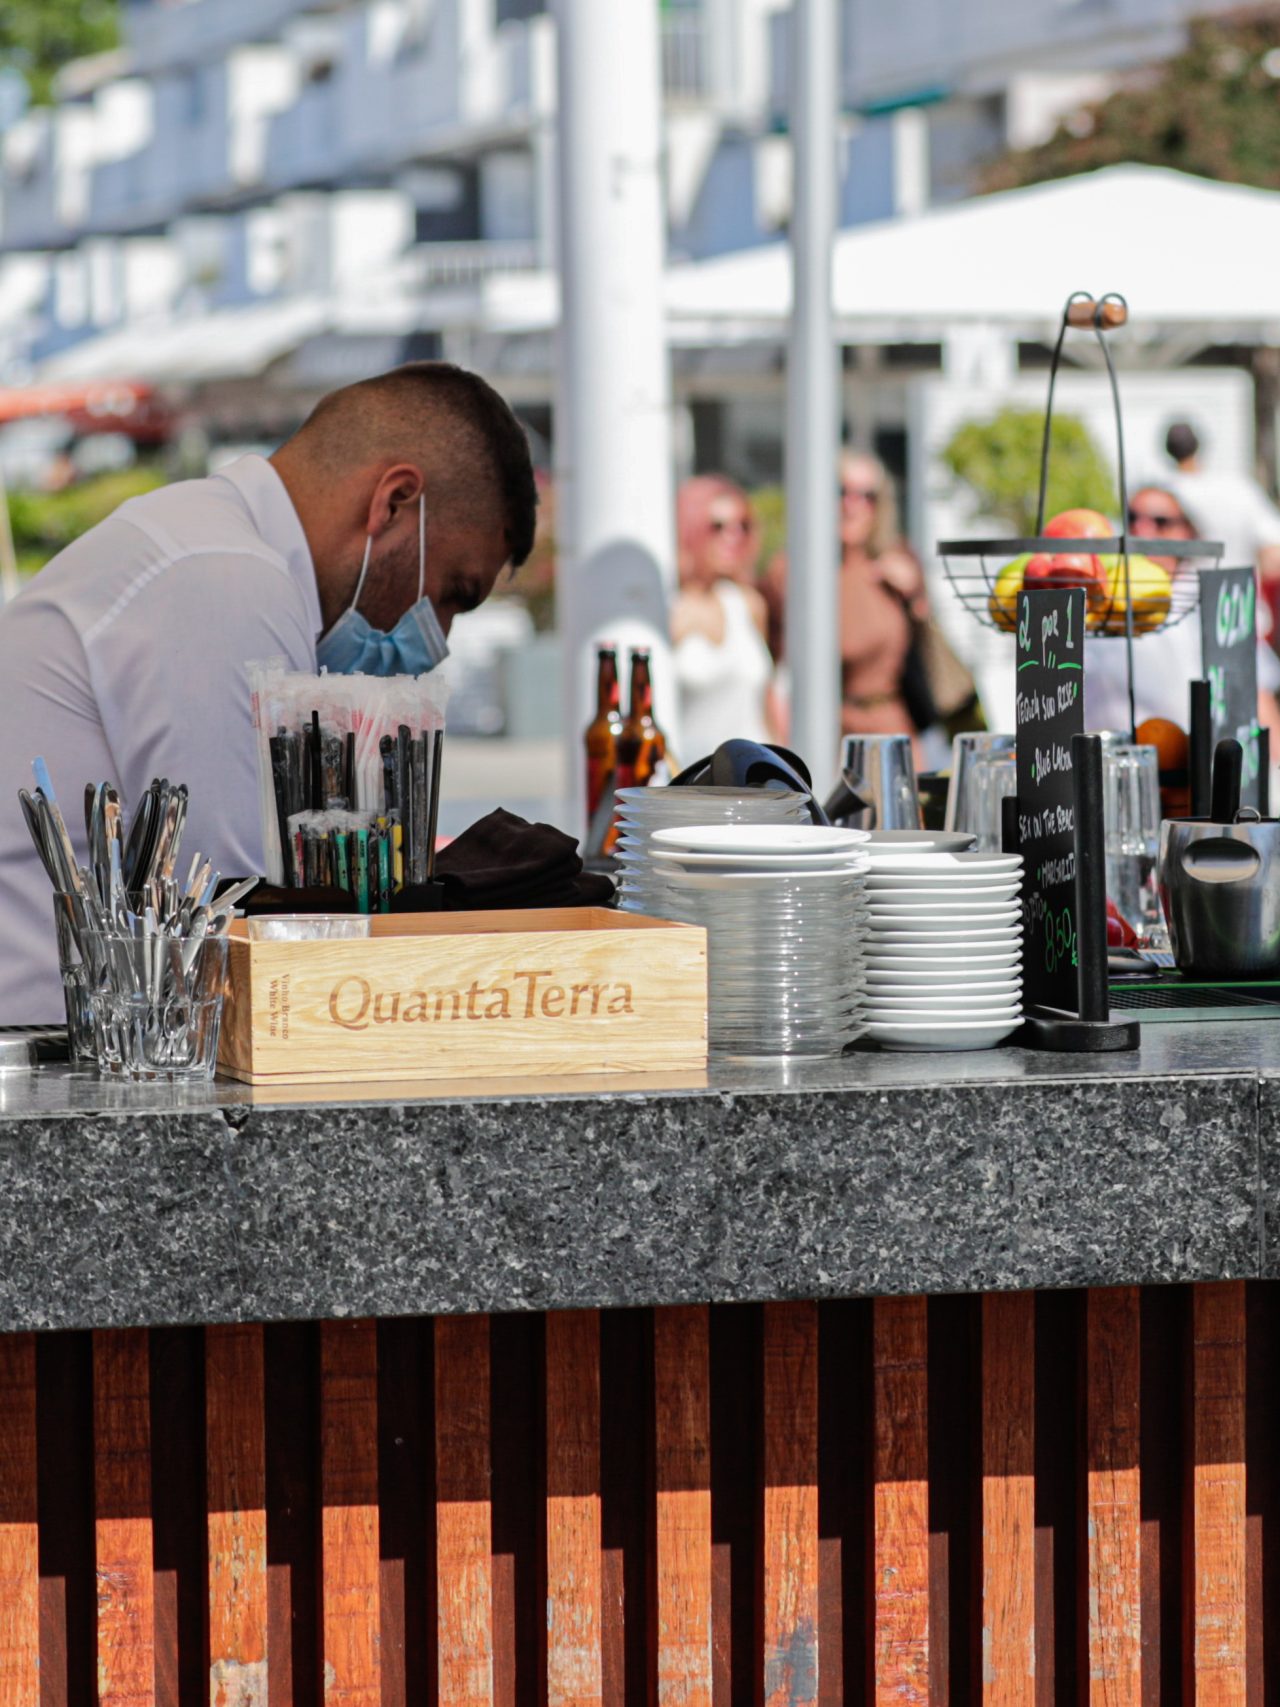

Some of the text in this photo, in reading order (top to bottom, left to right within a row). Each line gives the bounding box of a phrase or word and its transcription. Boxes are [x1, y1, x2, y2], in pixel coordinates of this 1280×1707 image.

[1019, 595, 1032, 652] 2
[1065, 594, 1075, 649] 1
[1057, 681, 1073, 712] RISE
[1018, 814, 1032, 844] SEX
[1033, 812, 1042, 839] ON
[1042, 808, 1056, 837] THE
[269, 980, 278, 1009] White
